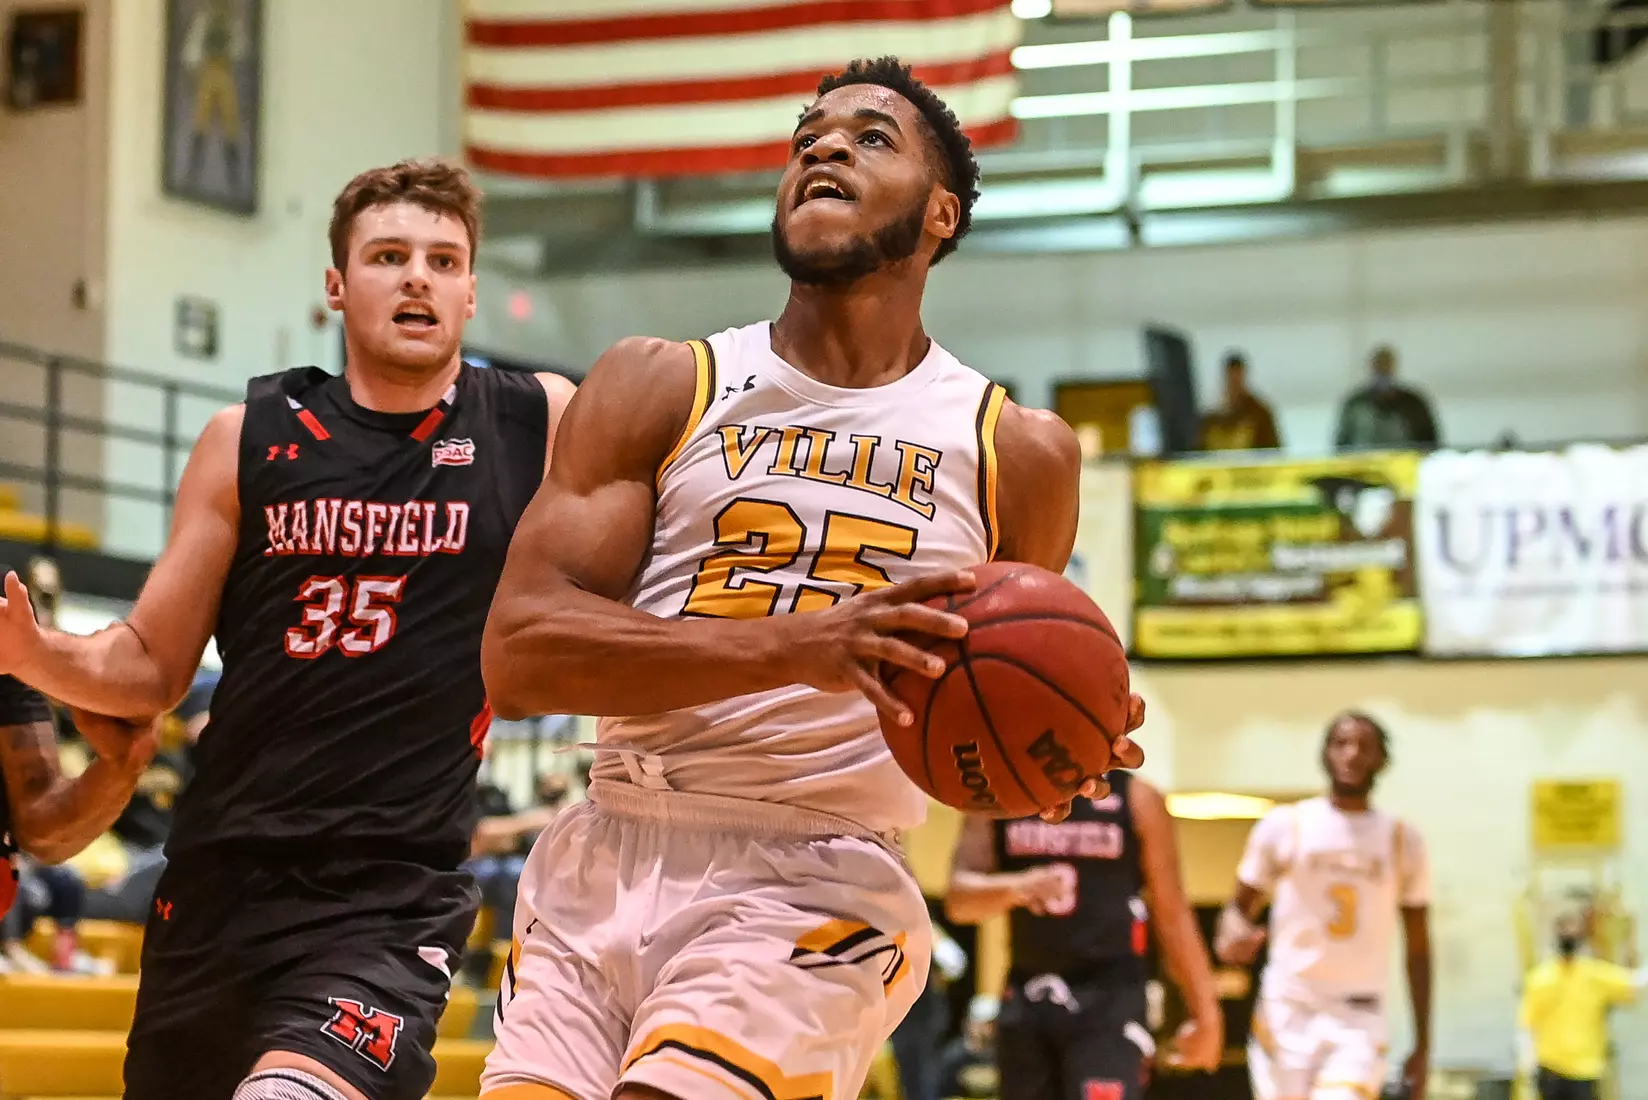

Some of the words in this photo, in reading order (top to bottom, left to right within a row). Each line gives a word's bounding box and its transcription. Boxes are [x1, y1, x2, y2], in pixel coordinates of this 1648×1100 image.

[716, 424, 943, 522] VILLE
[264, 498, 470, 557] MANSFIELD
[679, 496, 919, 618] 25
[284, 574, 408, 660] 35
[1324, 882, 1359, 940] 3
[320, 996, 404, 1072] M
